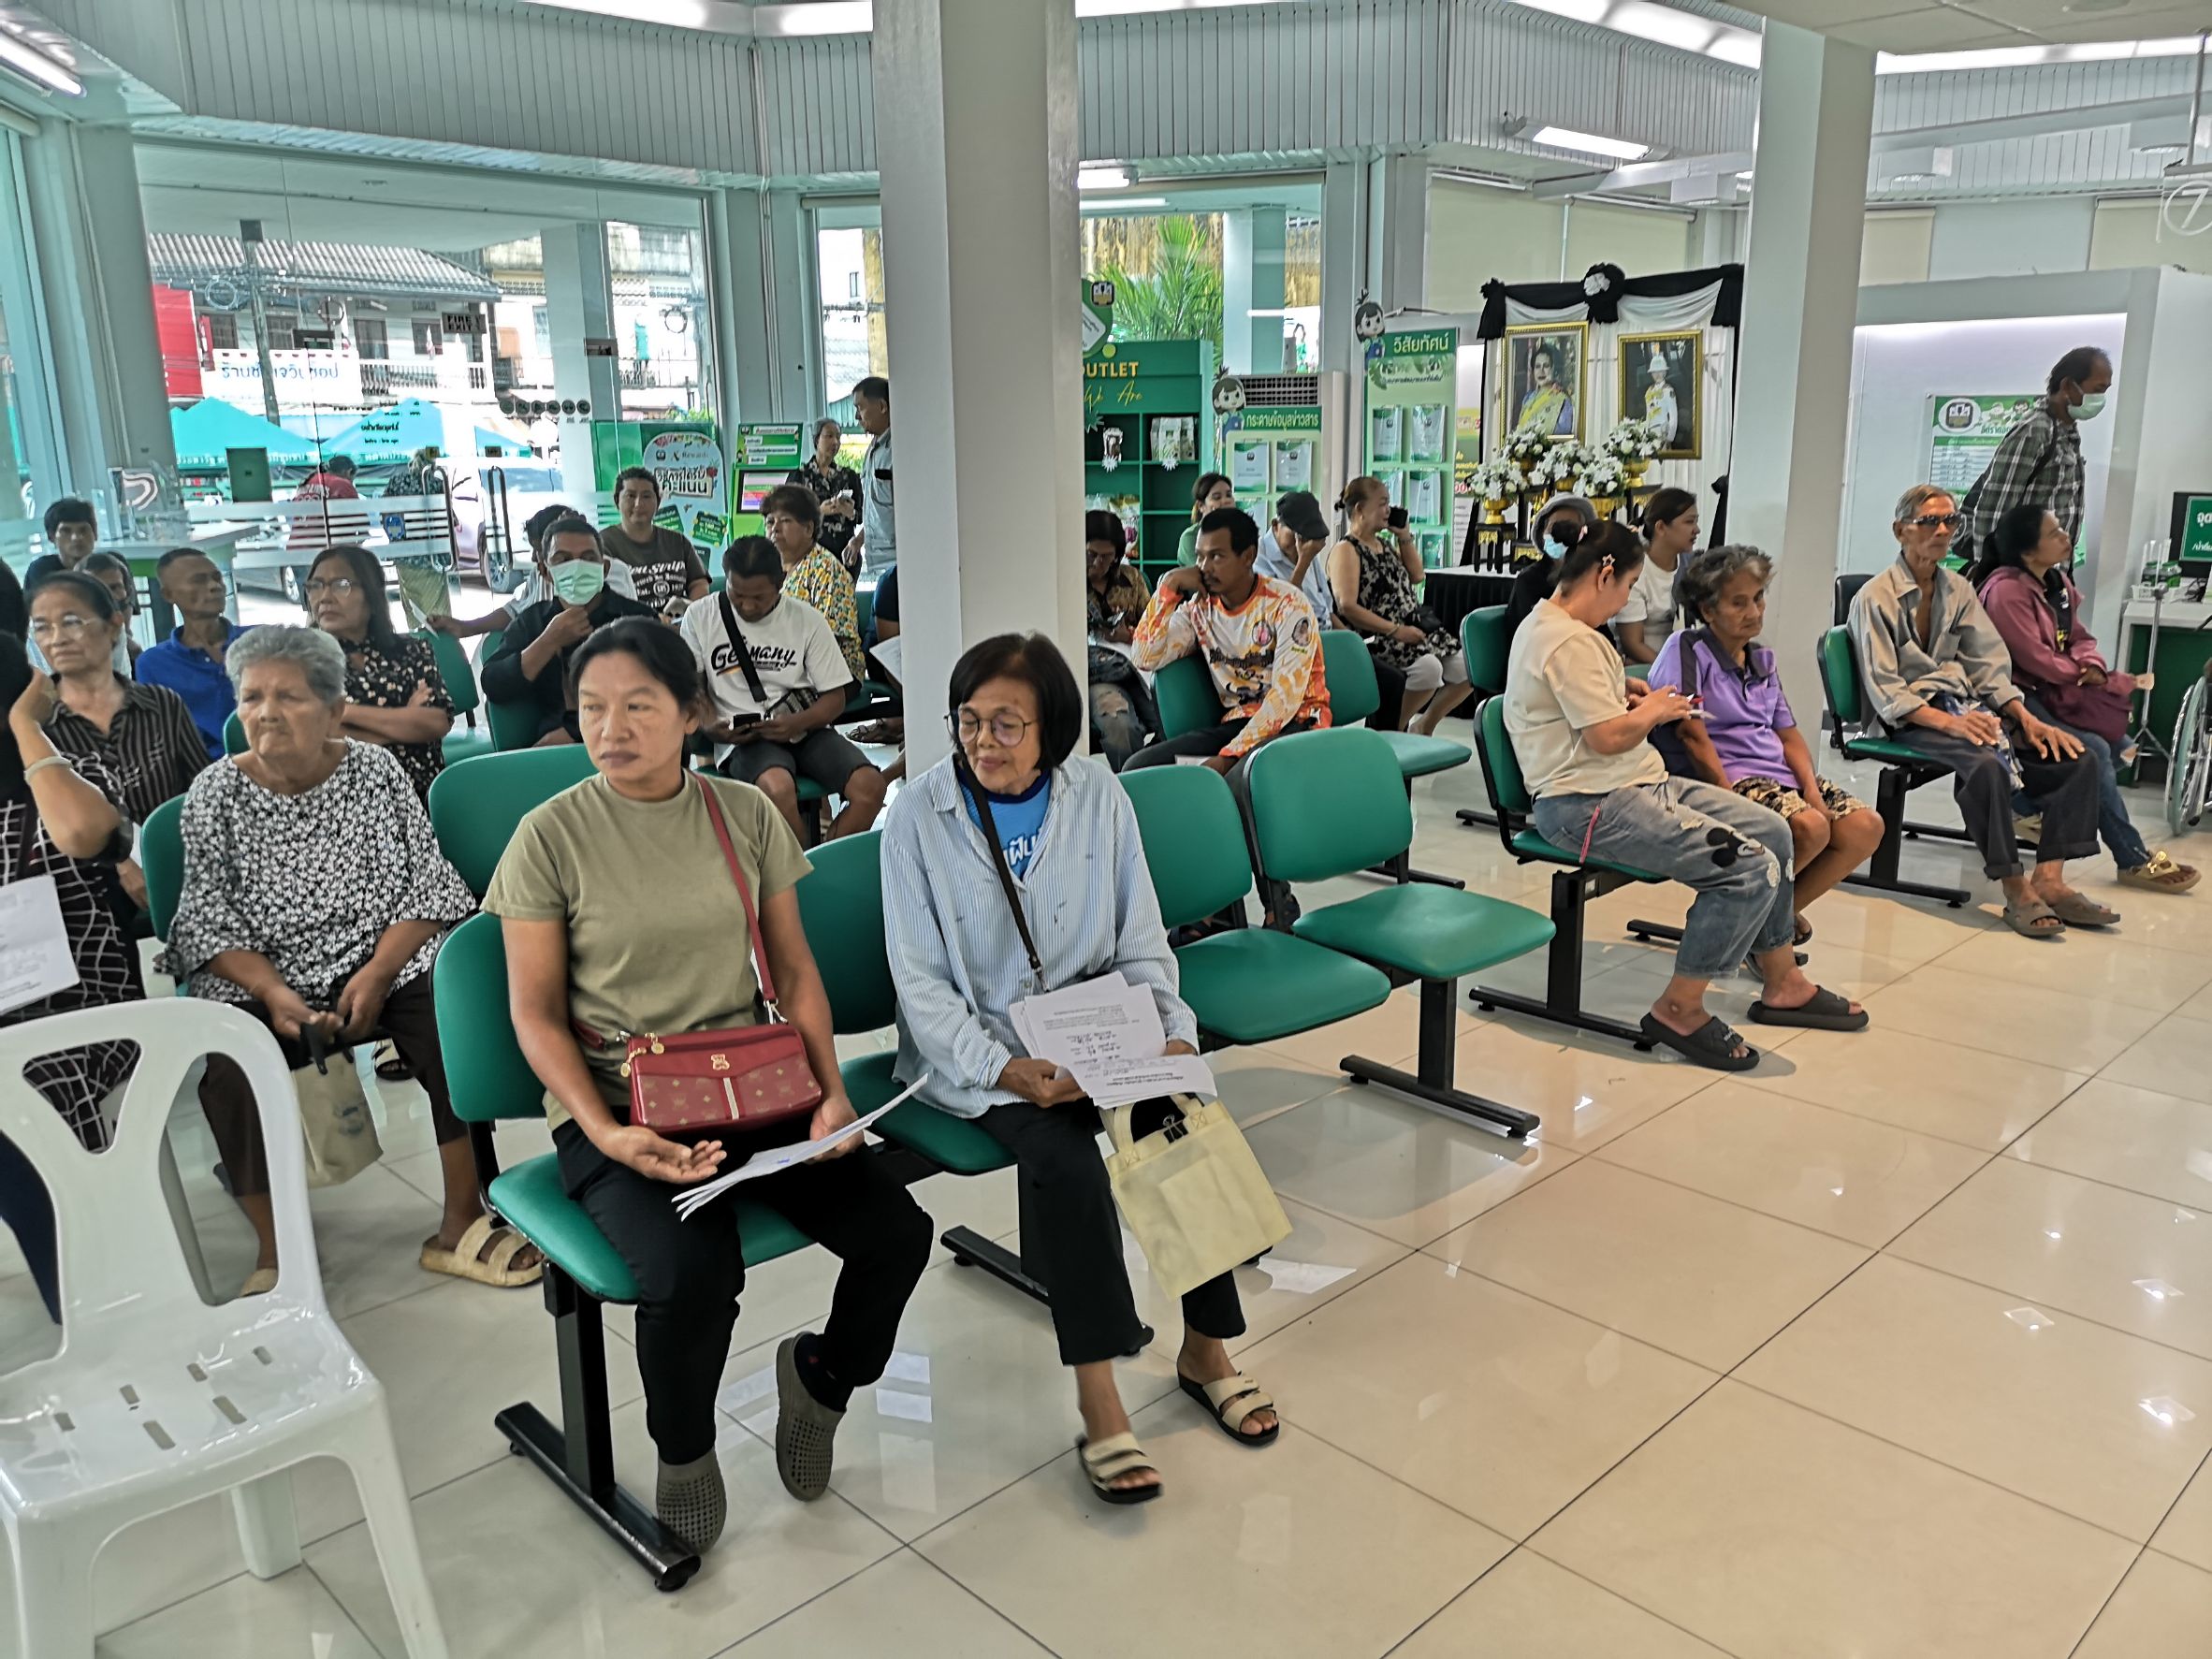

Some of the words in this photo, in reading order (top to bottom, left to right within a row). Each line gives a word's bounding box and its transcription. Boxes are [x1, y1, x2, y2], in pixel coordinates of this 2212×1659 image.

[1392, 331, 1449, 353] วิสัยทัศน์
[1082, 361, 1139, 378] UTLET
[662, 479, 707, 493] คะแนน
[711, 643, 797, 671] Gemany
